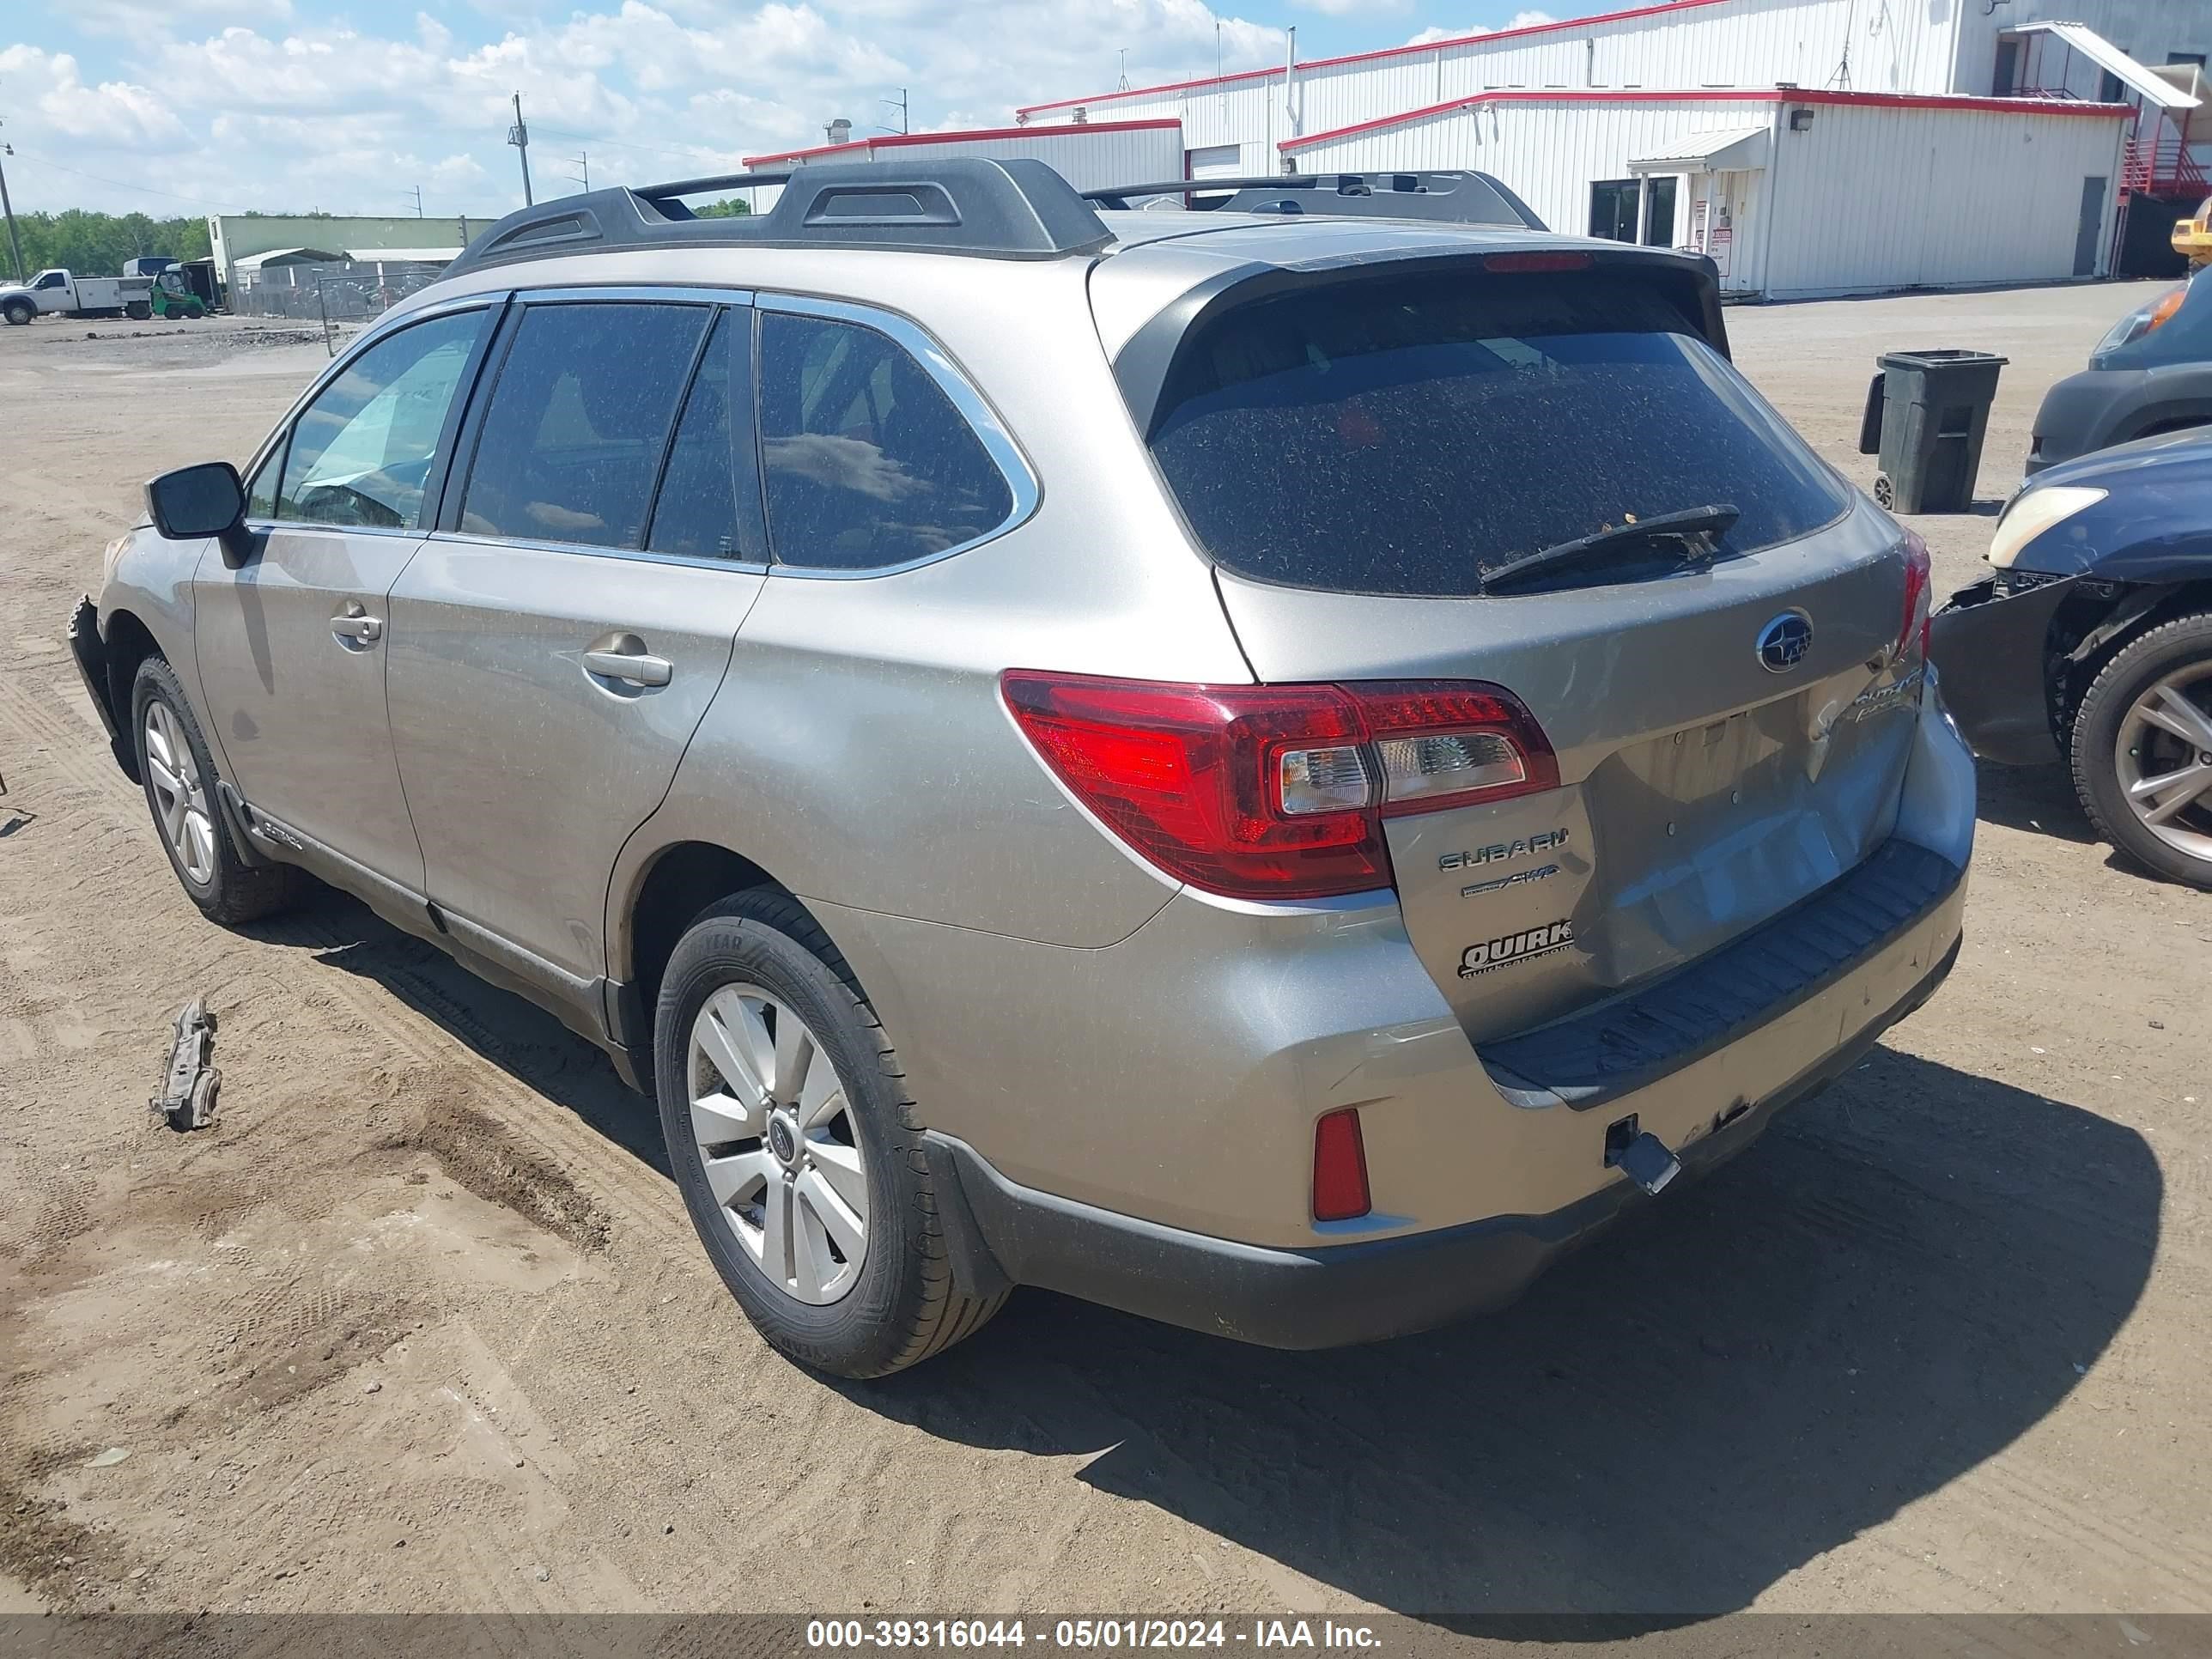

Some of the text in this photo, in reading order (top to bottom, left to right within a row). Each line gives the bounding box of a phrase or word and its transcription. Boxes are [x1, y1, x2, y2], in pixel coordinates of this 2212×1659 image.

[1439, 828, 1569, 872] SUBARU
[1462, 919, 1573, 969] QUIRK
[1462, 944, 1573, 980] quirkcars.com
